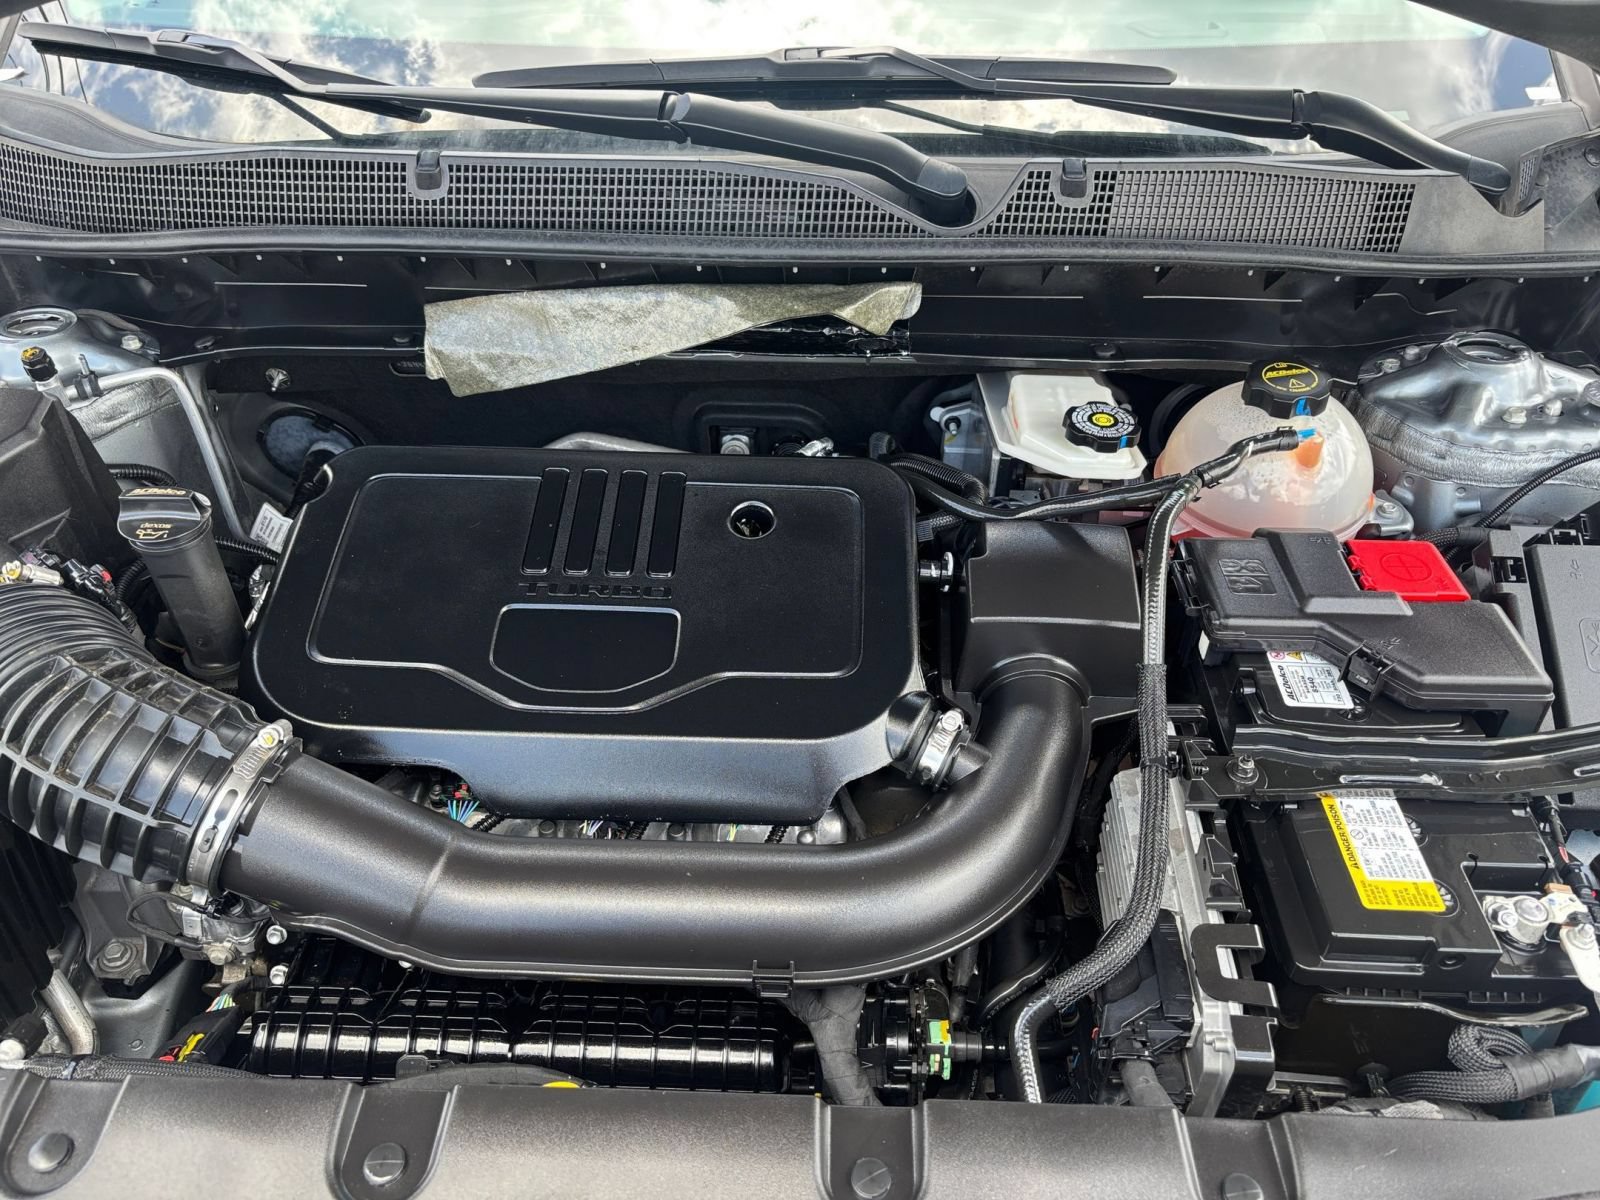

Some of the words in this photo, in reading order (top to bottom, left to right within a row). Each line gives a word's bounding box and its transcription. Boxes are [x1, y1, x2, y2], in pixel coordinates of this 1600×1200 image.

[1265, 368, 1309, 378] ACDelco
[125, 488, 187, 496] ACDelco
[518, 583, 672, 599] TURBO
[1277, 664, 1296, 701] ACDelco
[1327, 803, 1343, 830] POISON
[1339, 831, 1356, 863] DANGER
